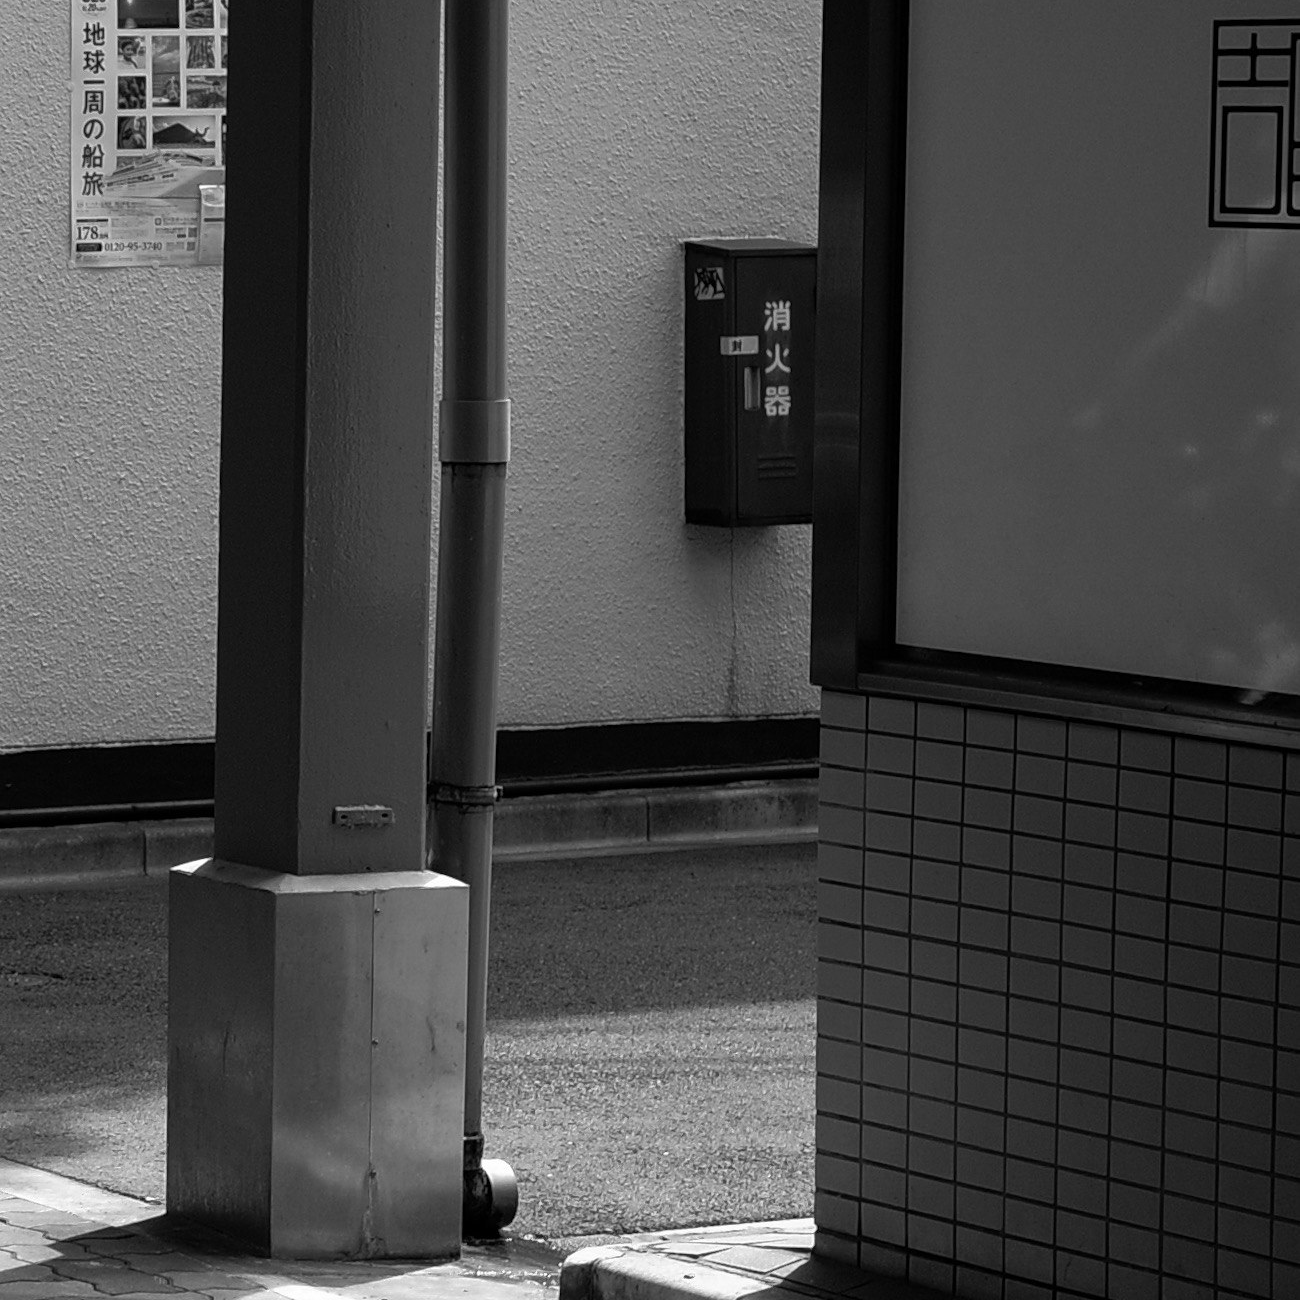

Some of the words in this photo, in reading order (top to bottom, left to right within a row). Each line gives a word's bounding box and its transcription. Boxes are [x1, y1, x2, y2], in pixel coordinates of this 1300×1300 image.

[82, 21, 105, 196] 地球一周の船旅
[76, 226, 99, 240] 178
[764, 299, 792, 417] 消火器
